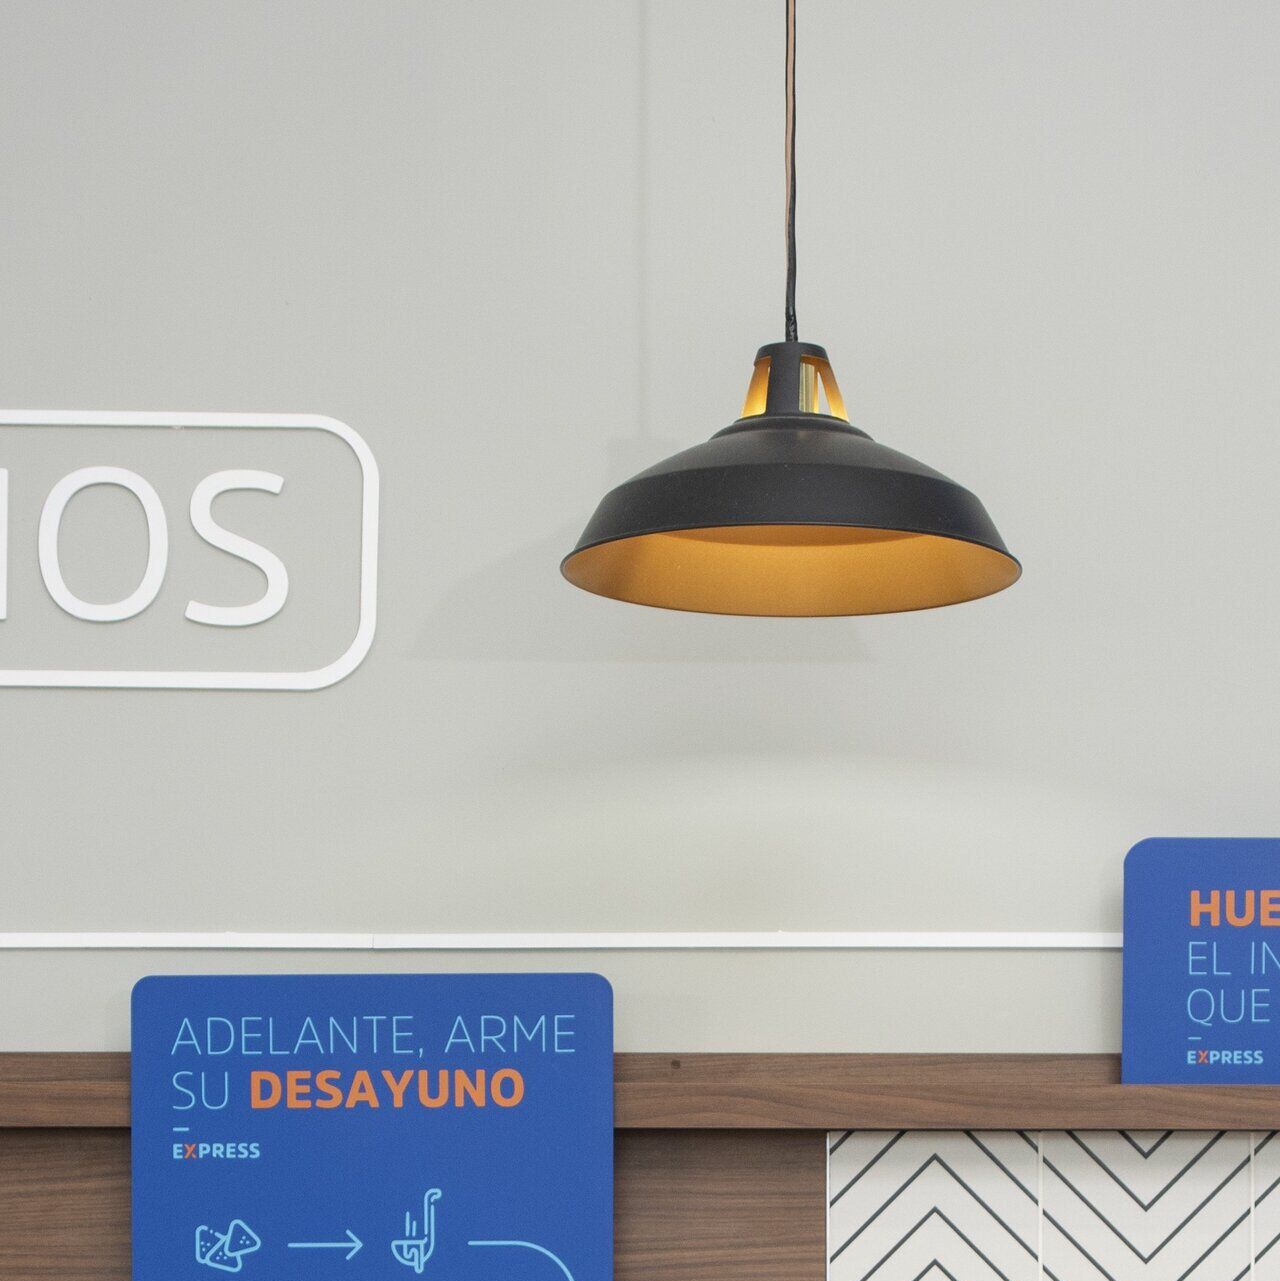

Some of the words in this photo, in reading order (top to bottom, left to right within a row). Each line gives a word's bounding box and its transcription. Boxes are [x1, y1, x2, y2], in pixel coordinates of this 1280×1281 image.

[1187, 941, 1231, 975] EL
[1186, 988, 1271, 1026] QUE
[171, 1015, 424, 1058] ADELANTE,
[445, 1014, 576, 1054] ARME
[1186, 1050, 1264, 1065] EXPRESS
[172, 1070, 229, 1110] SU
[250, 1068, 526, 1109] DESAYUNO
[172, 1142, 261, 1160] EXPRESS
